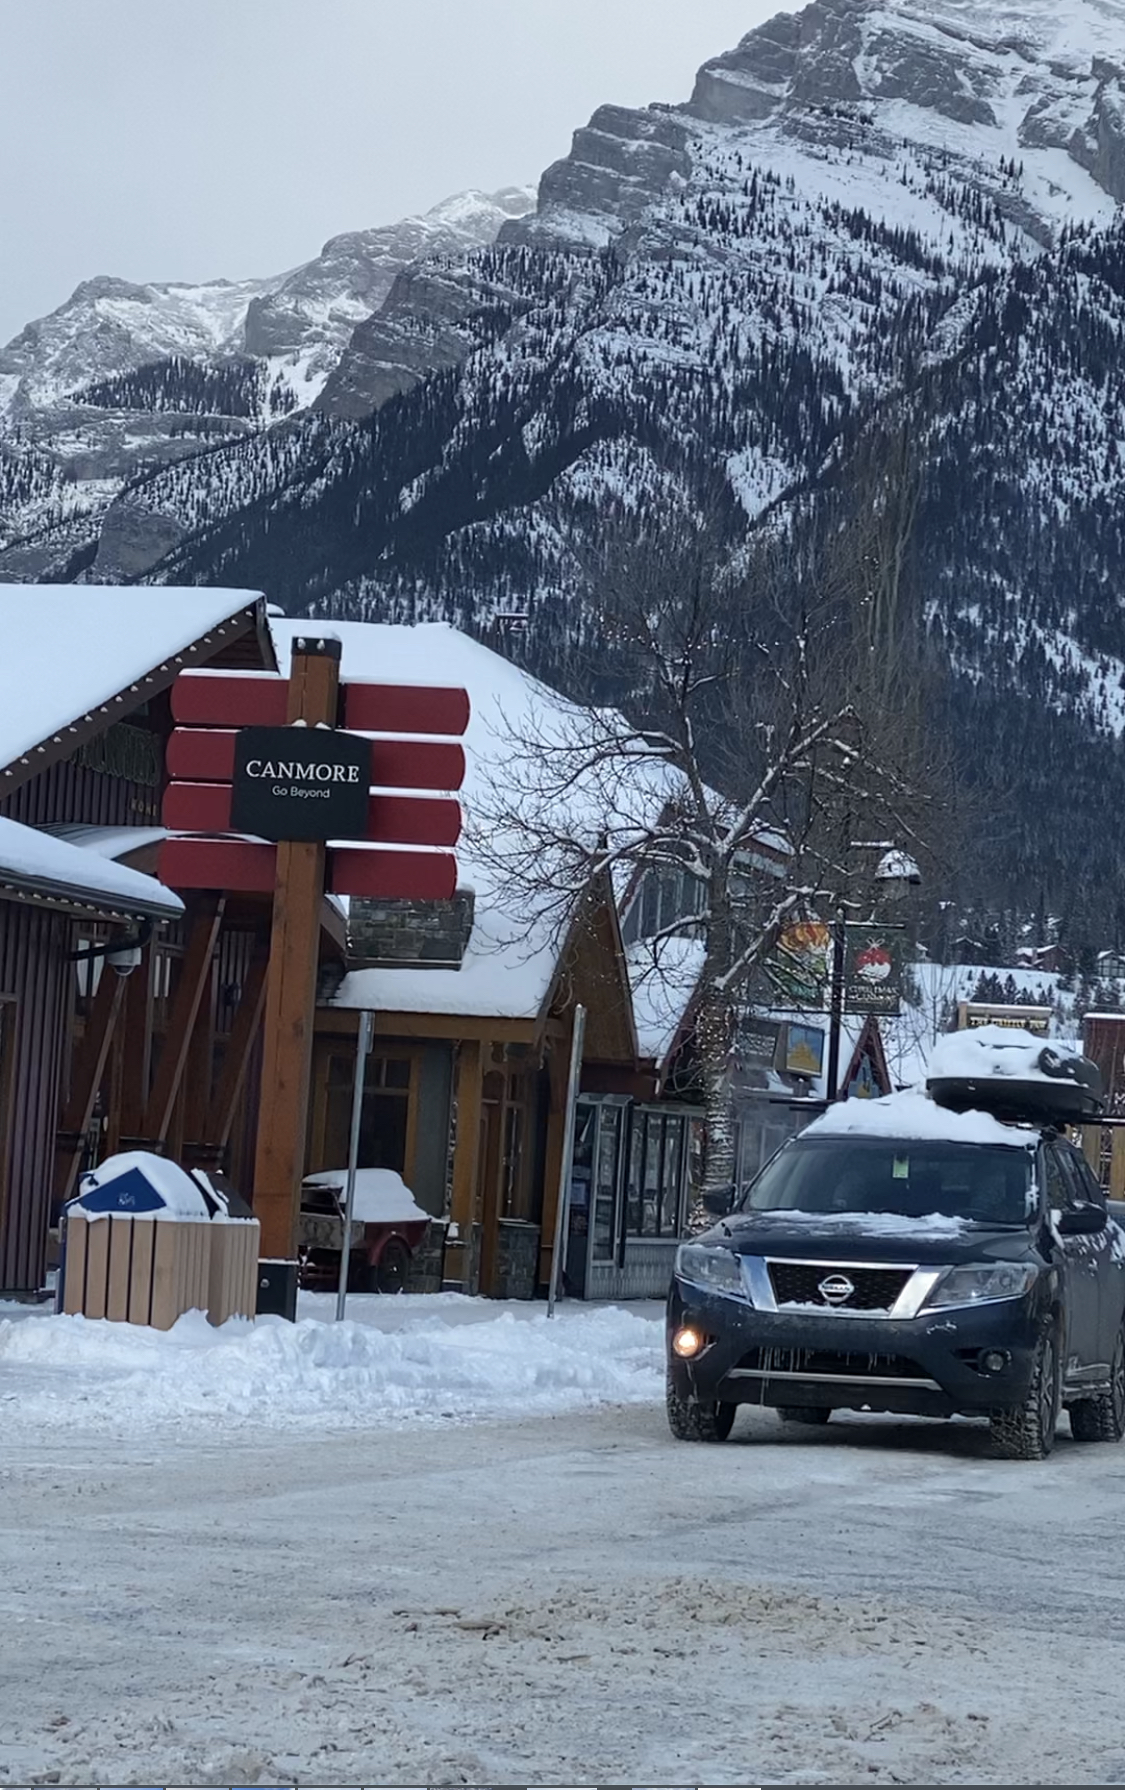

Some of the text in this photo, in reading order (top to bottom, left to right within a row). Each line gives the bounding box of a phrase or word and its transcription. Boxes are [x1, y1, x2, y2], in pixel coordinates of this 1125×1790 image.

[246, 760, 360, 783] CANMORE
[272, 785, 330, 799] Go Beyond
